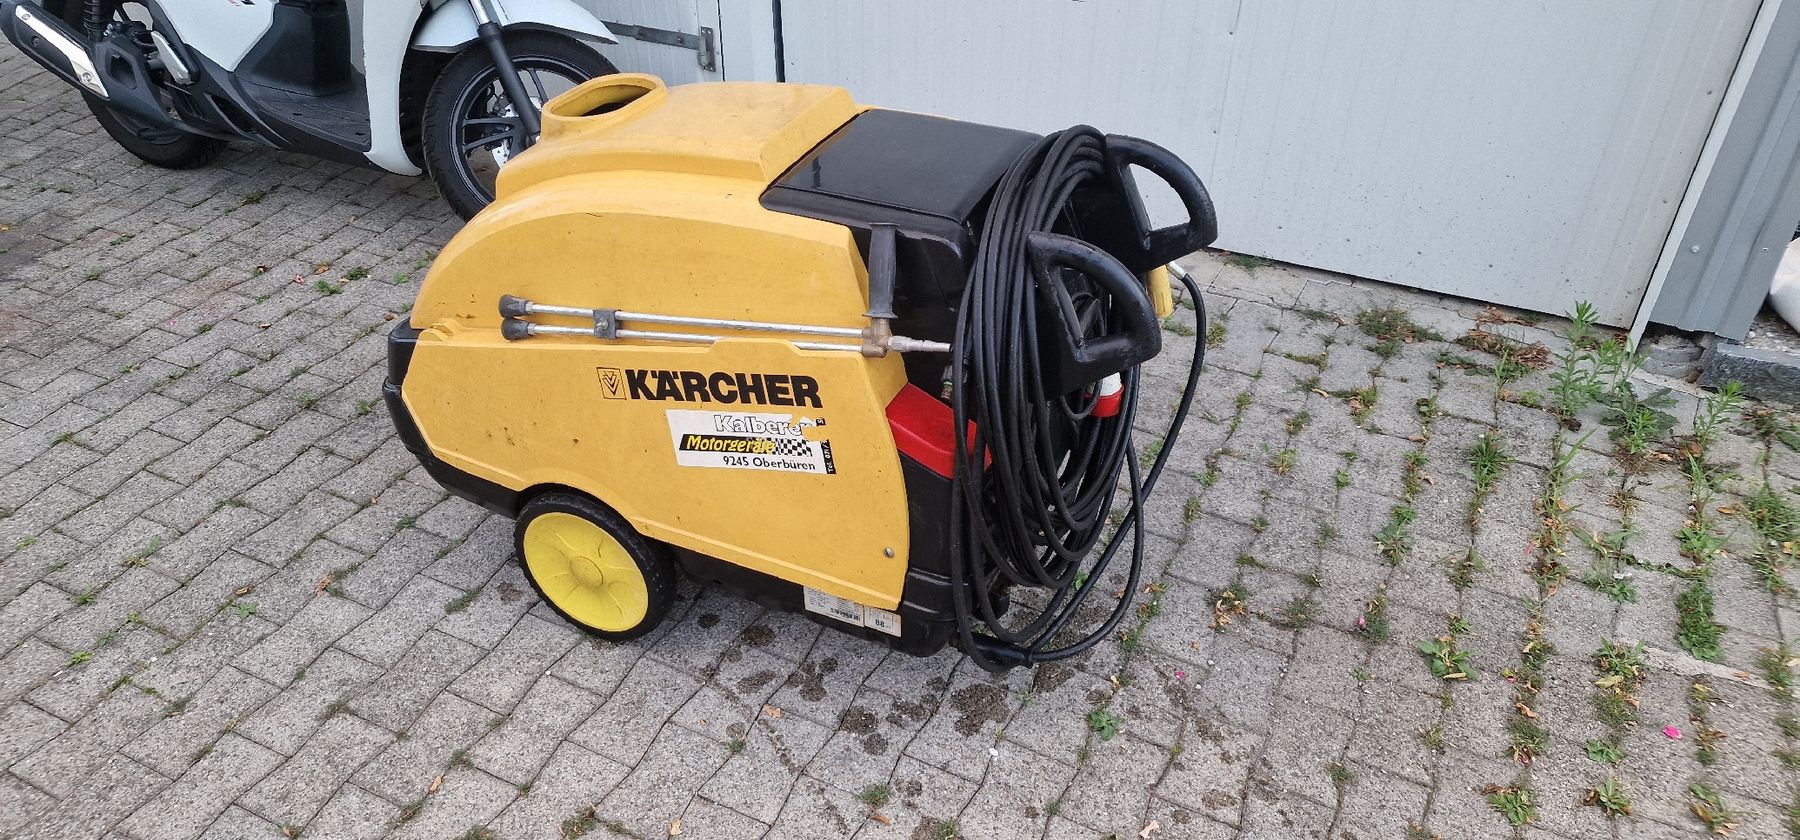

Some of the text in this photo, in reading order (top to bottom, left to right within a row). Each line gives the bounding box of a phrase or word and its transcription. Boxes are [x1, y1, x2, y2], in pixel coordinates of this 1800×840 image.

[625, 369, 823, 408] KÄRCHER
[714, 414, 812, 437] Kalbere
[723, 455, 816, 471] 9245 Oberbüren
